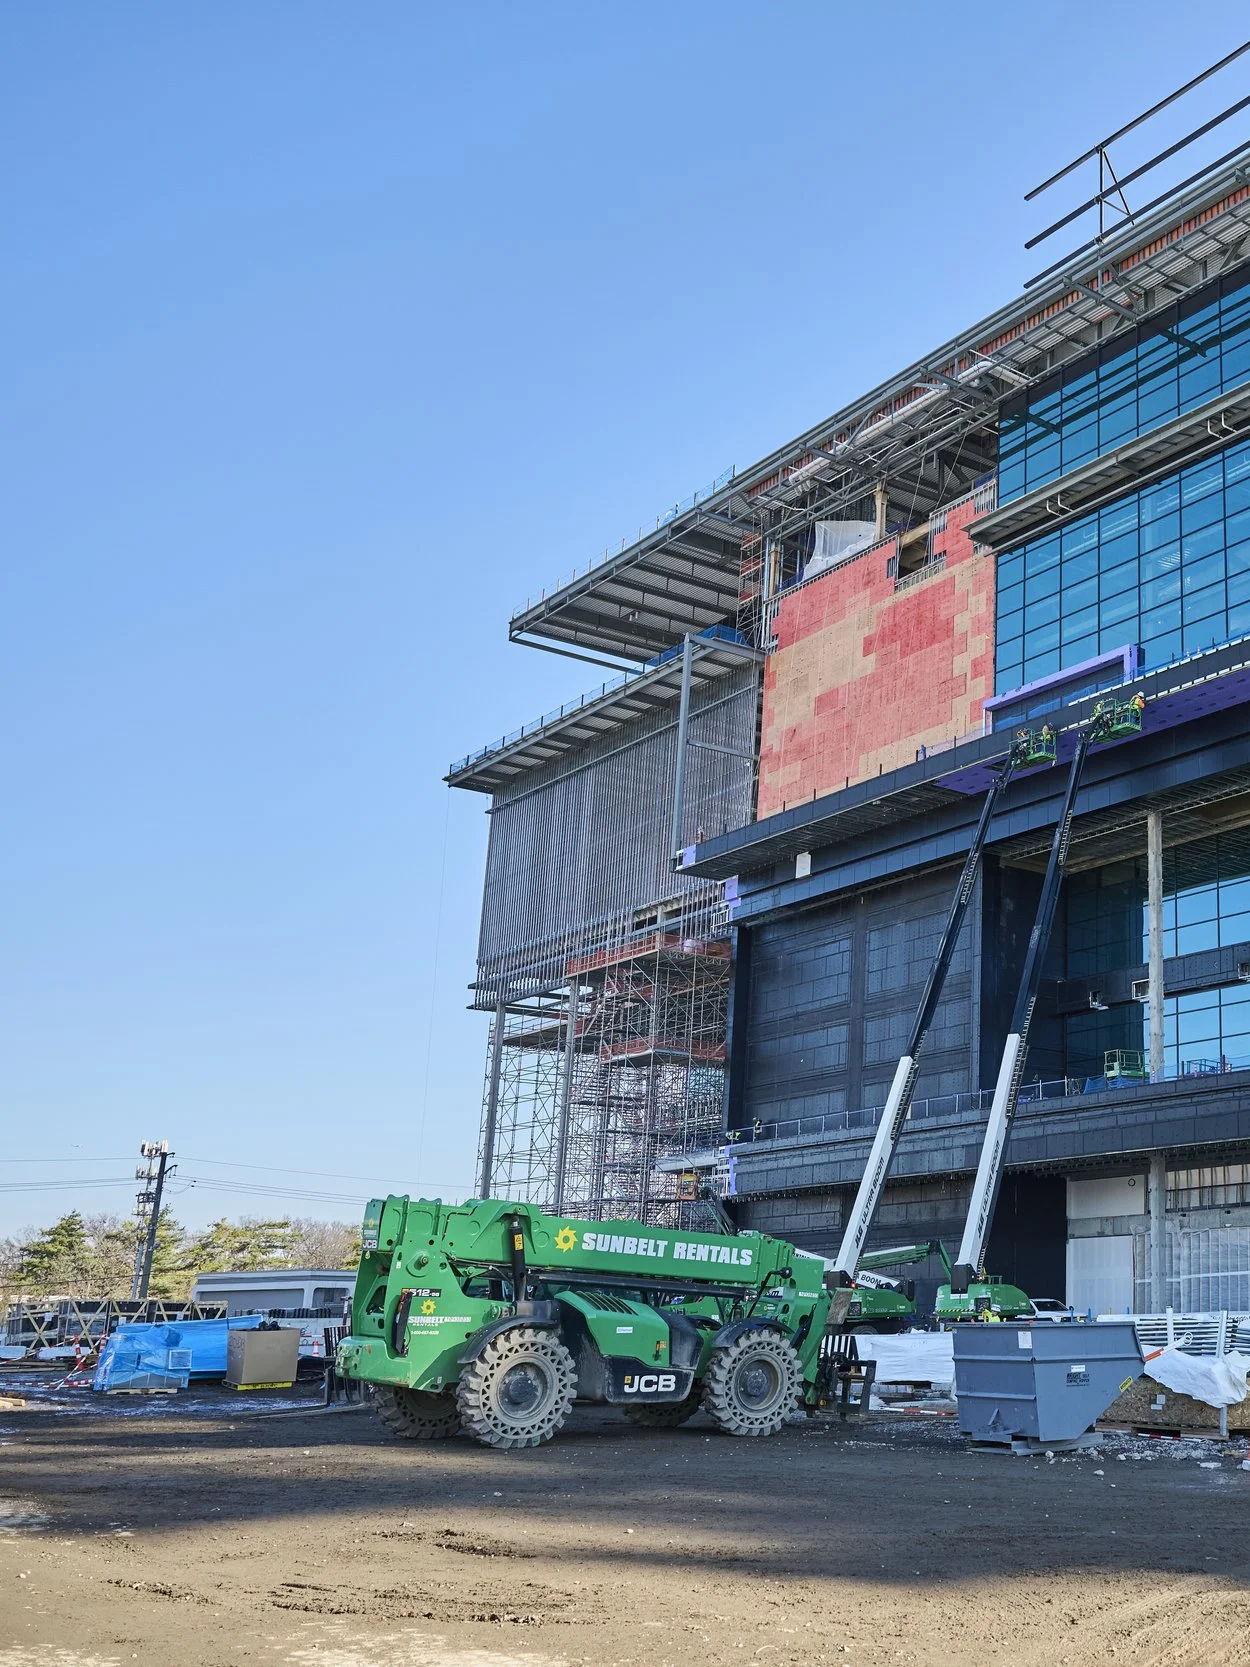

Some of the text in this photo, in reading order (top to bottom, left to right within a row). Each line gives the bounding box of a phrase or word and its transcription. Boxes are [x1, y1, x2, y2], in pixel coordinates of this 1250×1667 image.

[861, 1188, 875, 1225] ULTRA
[362, 1239, 378, 1249] JCB
[581, 1232, 753, 1266] SUNBELT RENTALS
[408, 1316, 445, 1324] SUNBELT
[623, 1374, 676, 1393] JCB
